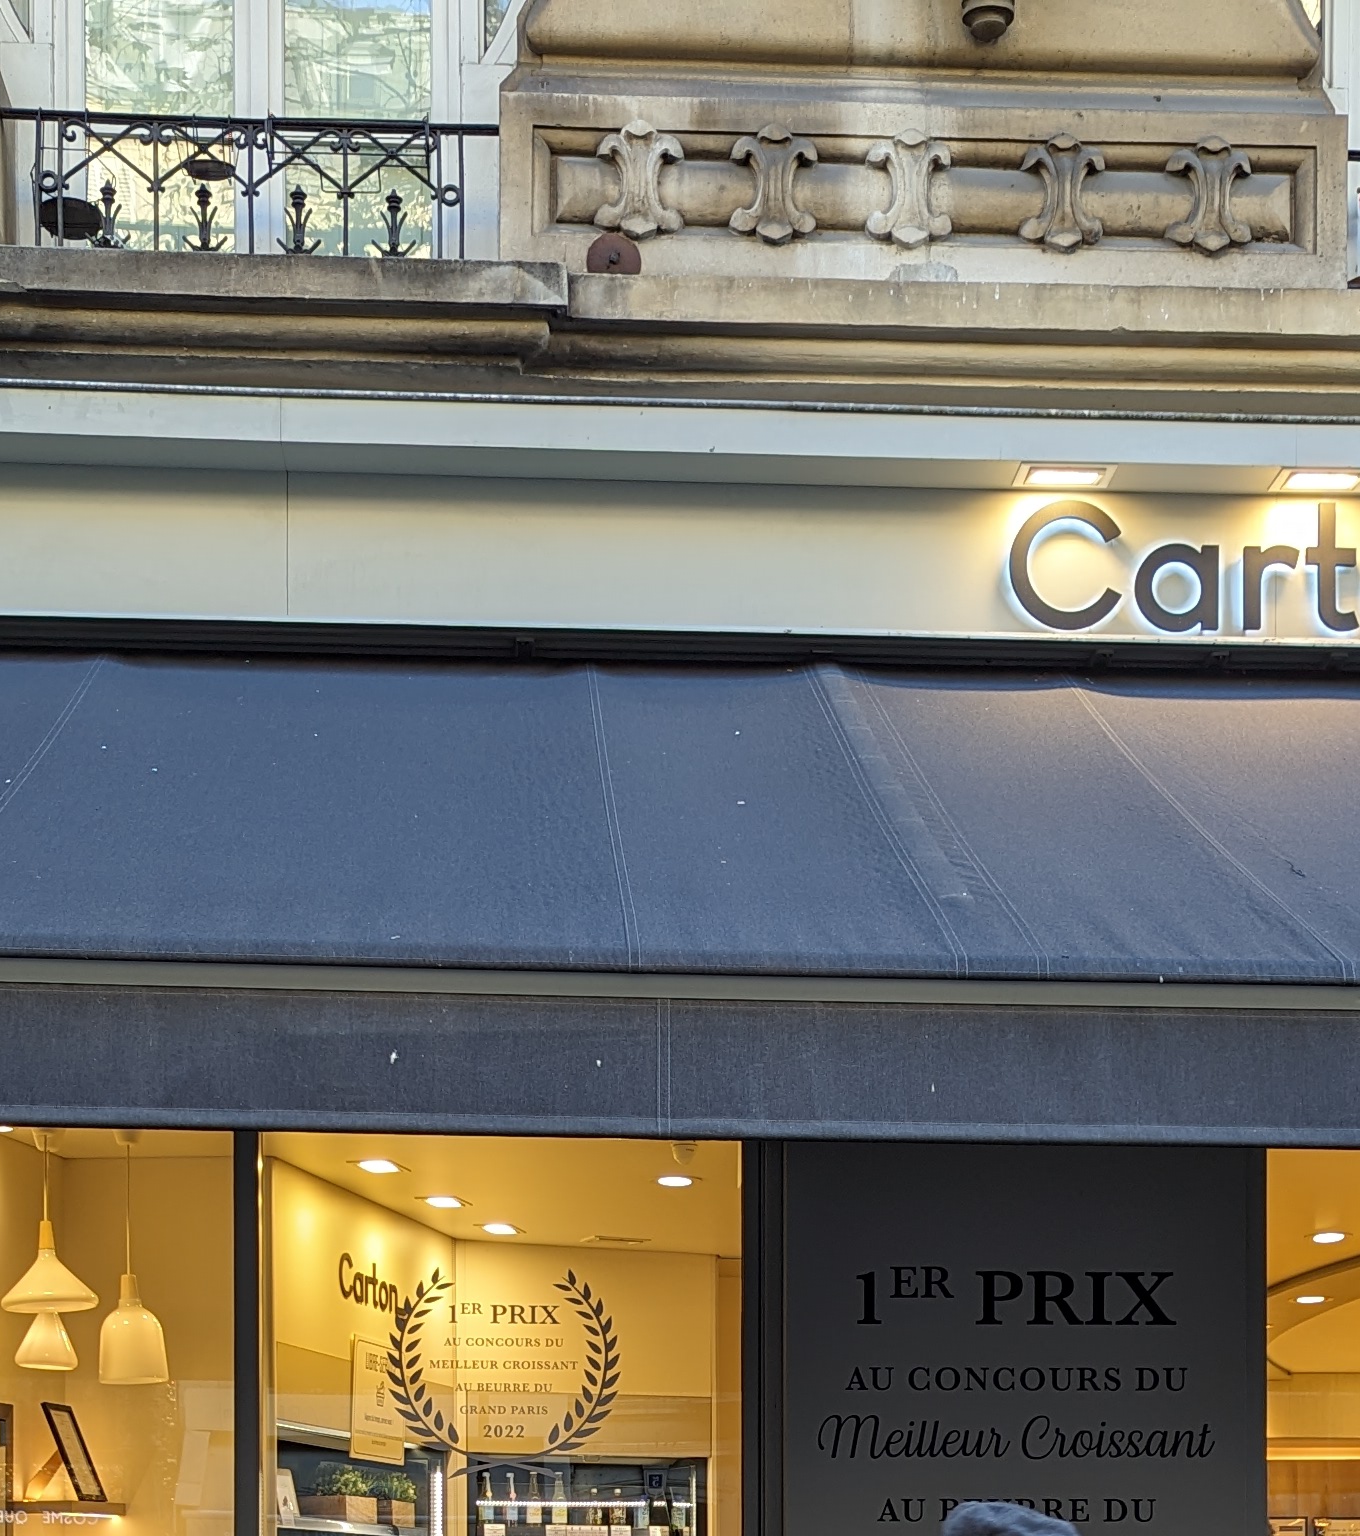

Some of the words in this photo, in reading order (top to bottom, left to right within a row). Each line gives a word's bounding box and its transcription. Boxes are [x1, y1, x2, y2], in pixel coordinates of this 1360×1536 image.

[338, 1252, 411, 1318] Carton
[856, 1265, 954, 1325] 1ER
[975, 1270, 1177, 1326] PRIX
[448, 1303, 483, 1325] 1ER
[490, 1304, 561, 1325] PRIX
[444, 1337, 462, 1348] AU
[465, 1337, 542, 1348] CONCOURS
[545, 1337, 565, 1348] DU
[429, 1360, 499, 1370] MEILLEUR
[502, 1360, 578, 1370] CROISSANT
[455, 1382, 473, 1393] AU
[476, 1382, 531, 1393] BEURRE
[533, 1382, 553, 1393] DU
[845, 1366, 894, 1392] AU
[908, 1366, 1122, 1392] CONCOURS
[1135, 1366, 1188, 1392] DU
[459, 1405, 507, 1415] GRAND
[510, 1405, 549, 1415] PARIS
[483, 1424, 525, 1439] 2022
[817, 1414, 1010, 1459] Meilleur
[1021, 1415, 1216, 1459] Croissant
[877, 1498, 926, 1523] AU
[1103, 1498, 1157, 1523] DU
